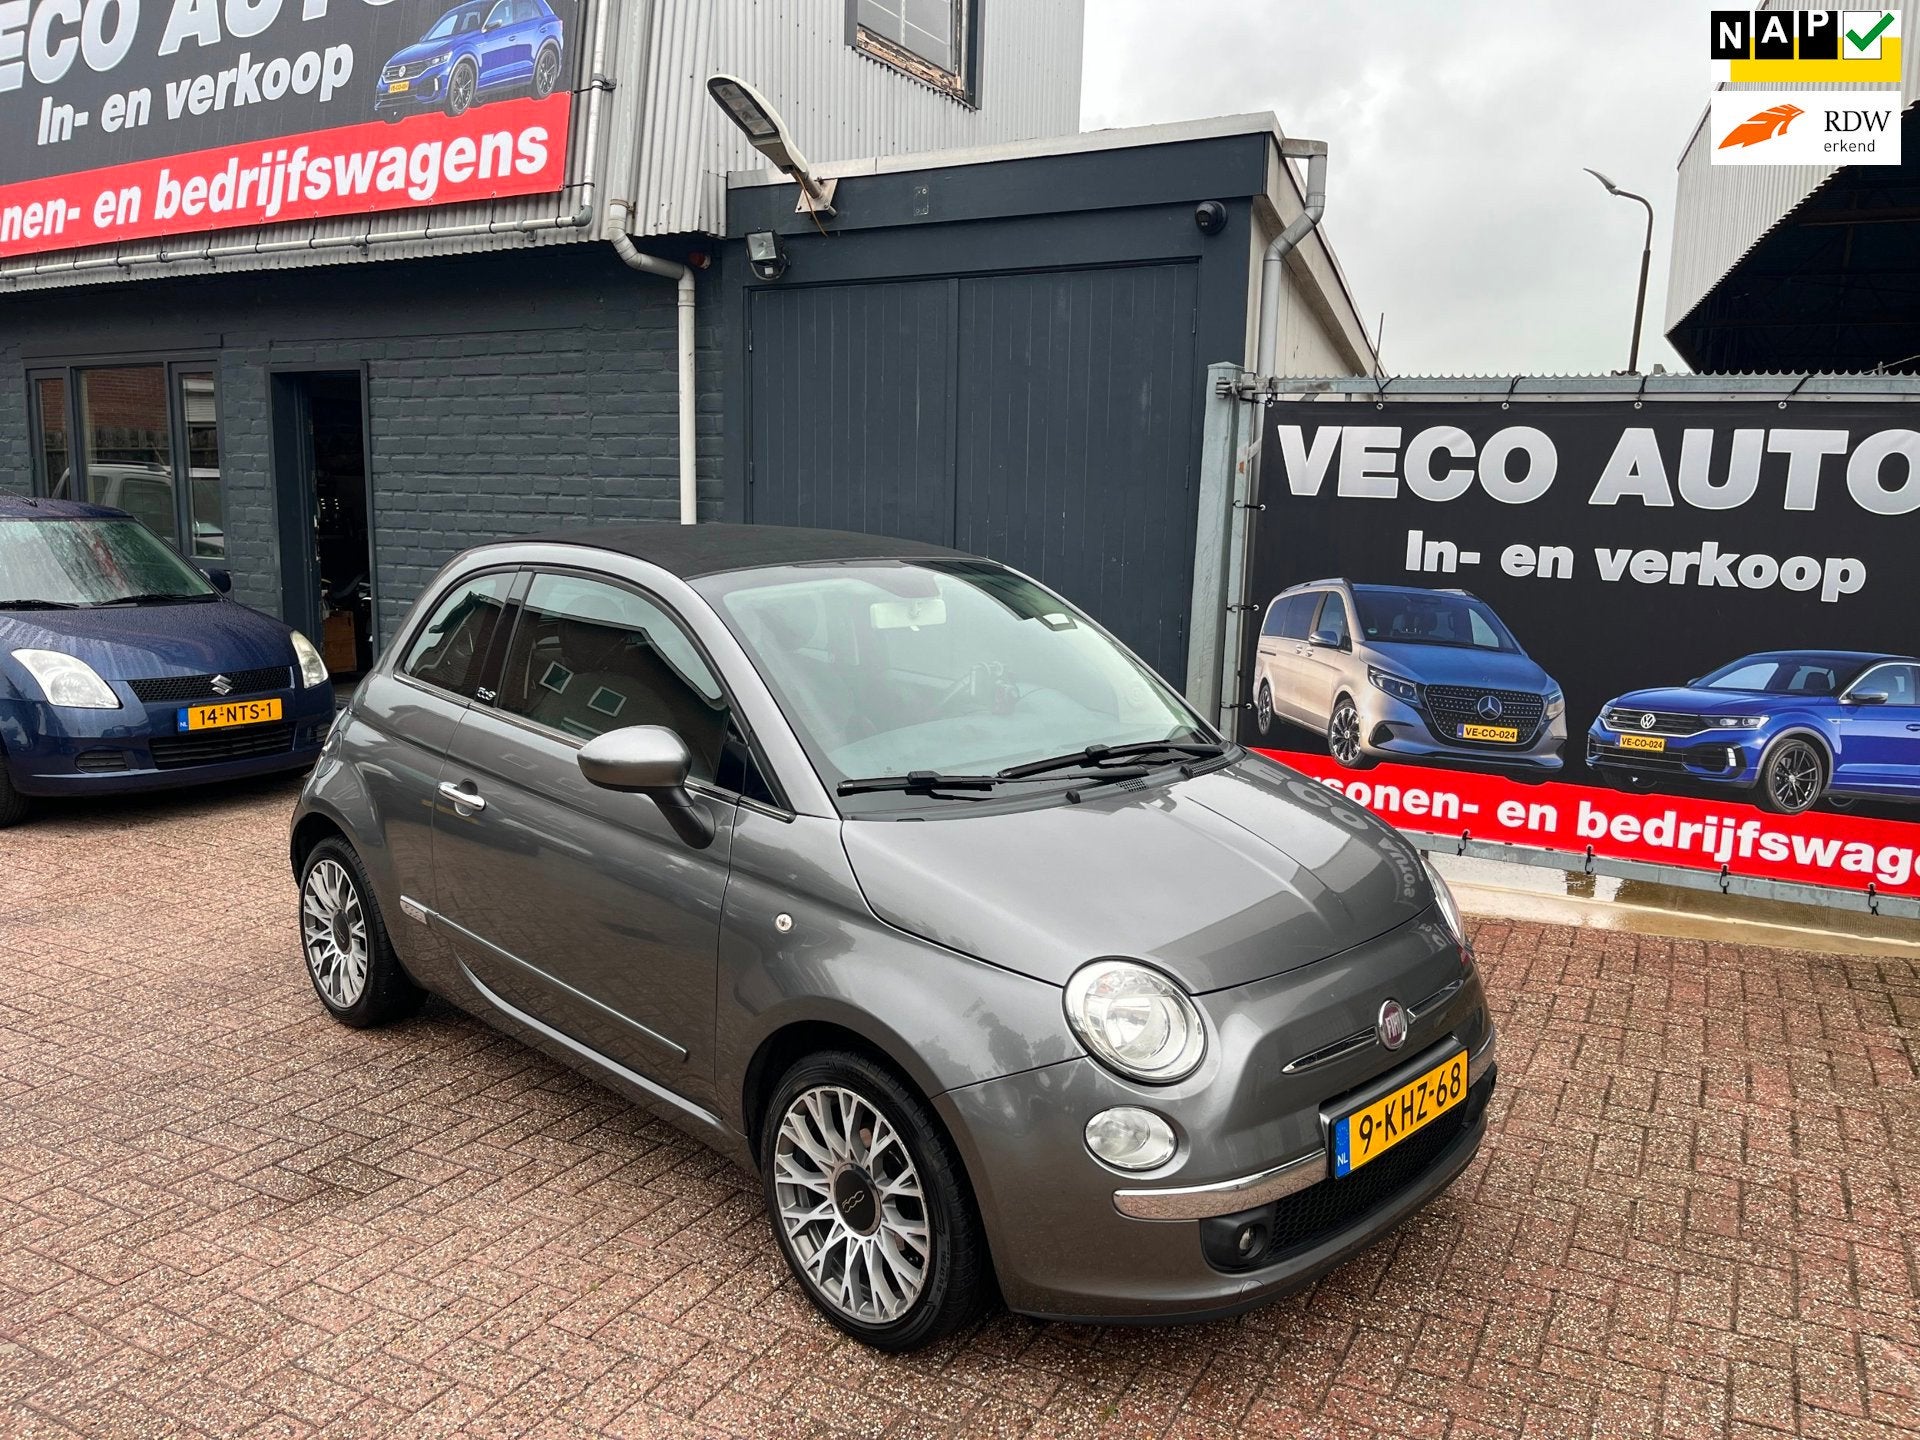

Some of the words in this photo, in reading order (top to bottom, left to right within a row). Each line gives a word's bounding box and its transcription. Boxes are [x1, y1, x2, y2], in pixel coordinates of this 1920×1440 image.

[37, 96, 89, 146] In-
[101, 86, 151, 133] en
[165, 42, 354, 120] verkoop
[93, 185, 142, 228] en
[154, 126, 549, 220] bedrijfswagens
[1277, 425, 1558, 503] VECO
[1405, 530, 1480, 573] In-
[1500, 541, 1574, 580] en
[1595, 541, 1867, 603] verkoop
[200, 702, 271, 726] 14-NTS-1
[1465, 727, 1515, 740] VE-CO-024
[1621, 737, 1662, 749] VE-CO-024
[1497, 796, 1559, 833] en
[1576, 800, 1920, 886] bedrijfswag
[1337, 1151, 1349, 1167] NL
[1358, 1062, 1461, 1155] 9-KHZ-68
